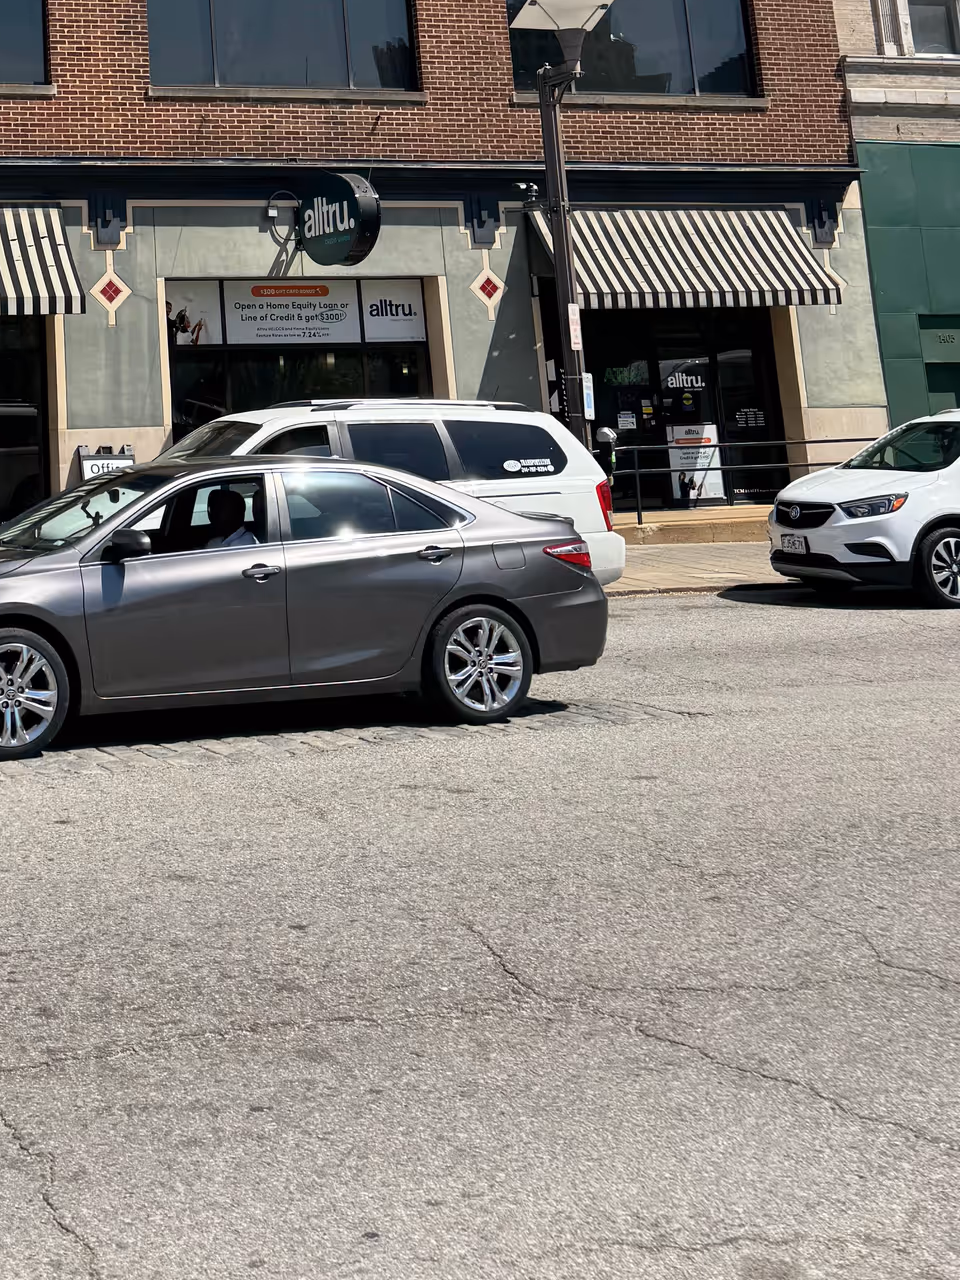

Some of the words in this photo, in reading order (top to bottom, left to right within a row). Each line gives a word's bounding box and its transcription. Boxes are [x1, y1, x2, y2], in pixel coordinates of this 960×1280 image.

[304, 197, 355, 238] alltru.
[234, 302, 257, 311] Open
[292, 301, 316, 311] Equity
[369, 298, 417, 317] alltru.
[260, 313, 268, 321] of
[270, 313, 295, 321] Credit
[297, 313, 303, 321] &
[305, 314, 318, 323] get
[668, 372, 706, 388] alltru.
